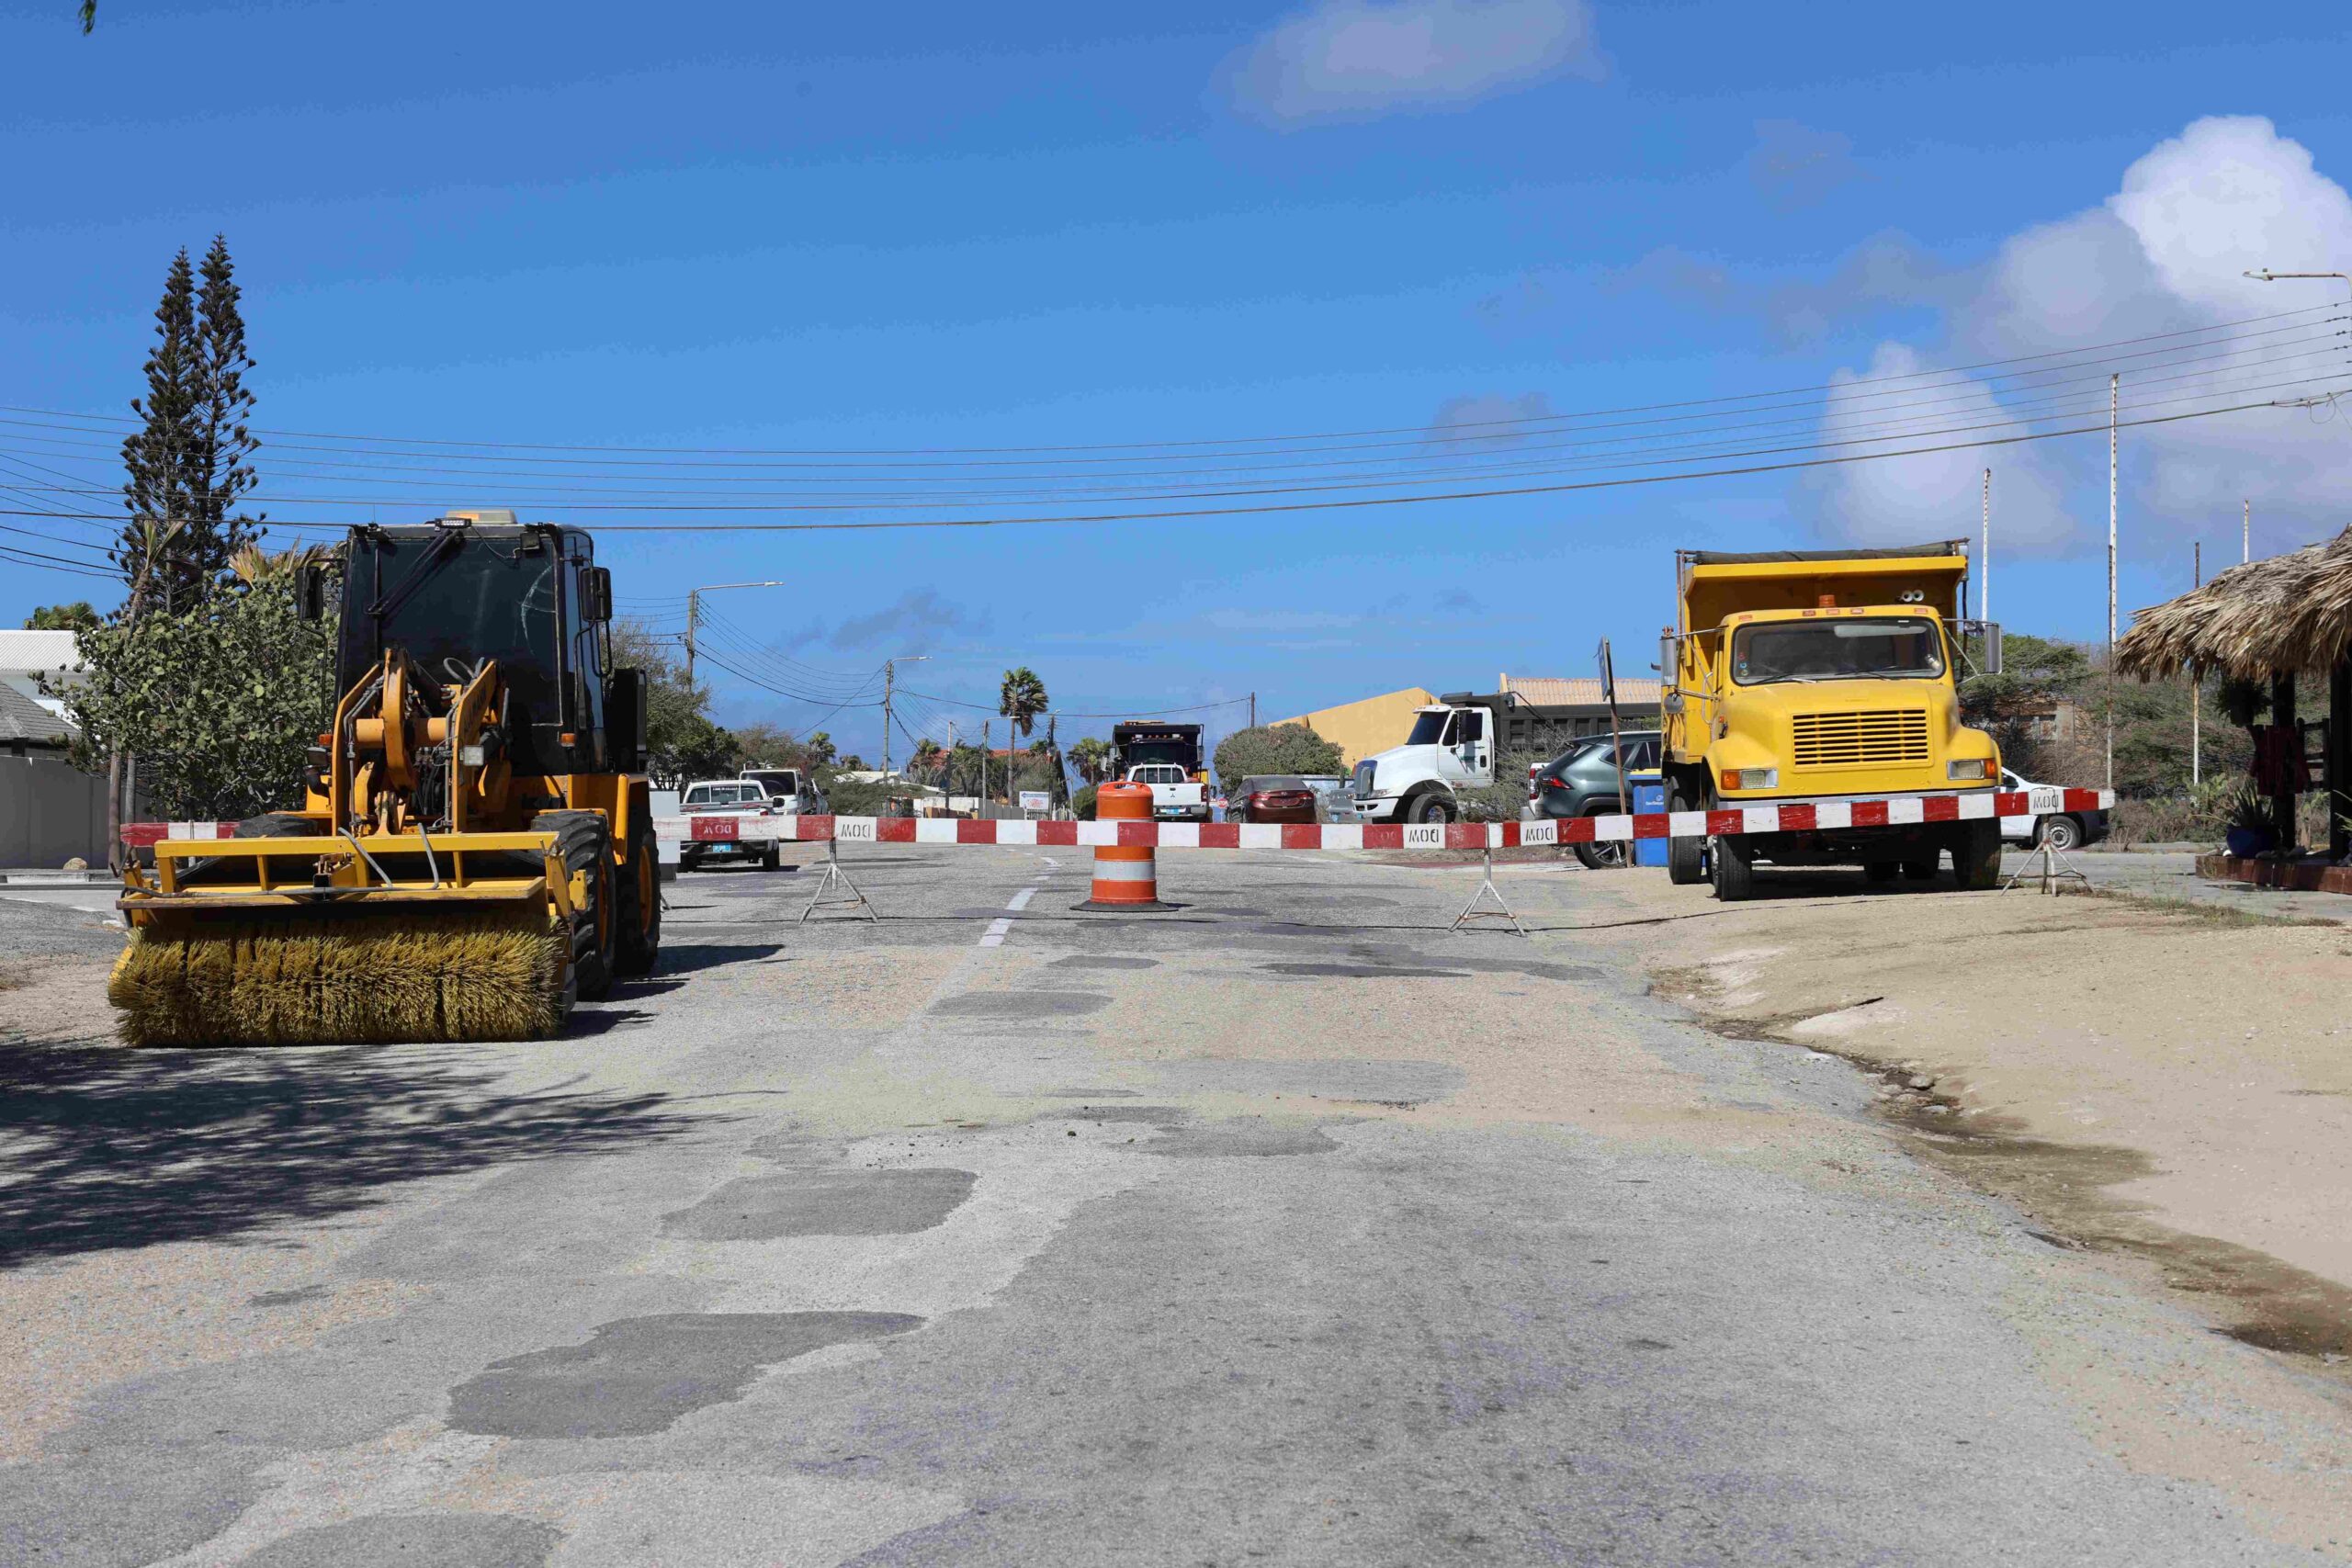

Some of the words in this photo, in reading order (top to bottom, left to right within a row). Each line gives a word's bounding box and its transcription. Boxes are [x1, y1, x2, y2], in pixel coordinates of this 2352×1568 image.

[841, 823, 871, 838] DOW
[1408, 829, 1439, 843] DOW
[1525, 827, 1554, 841] DOW
